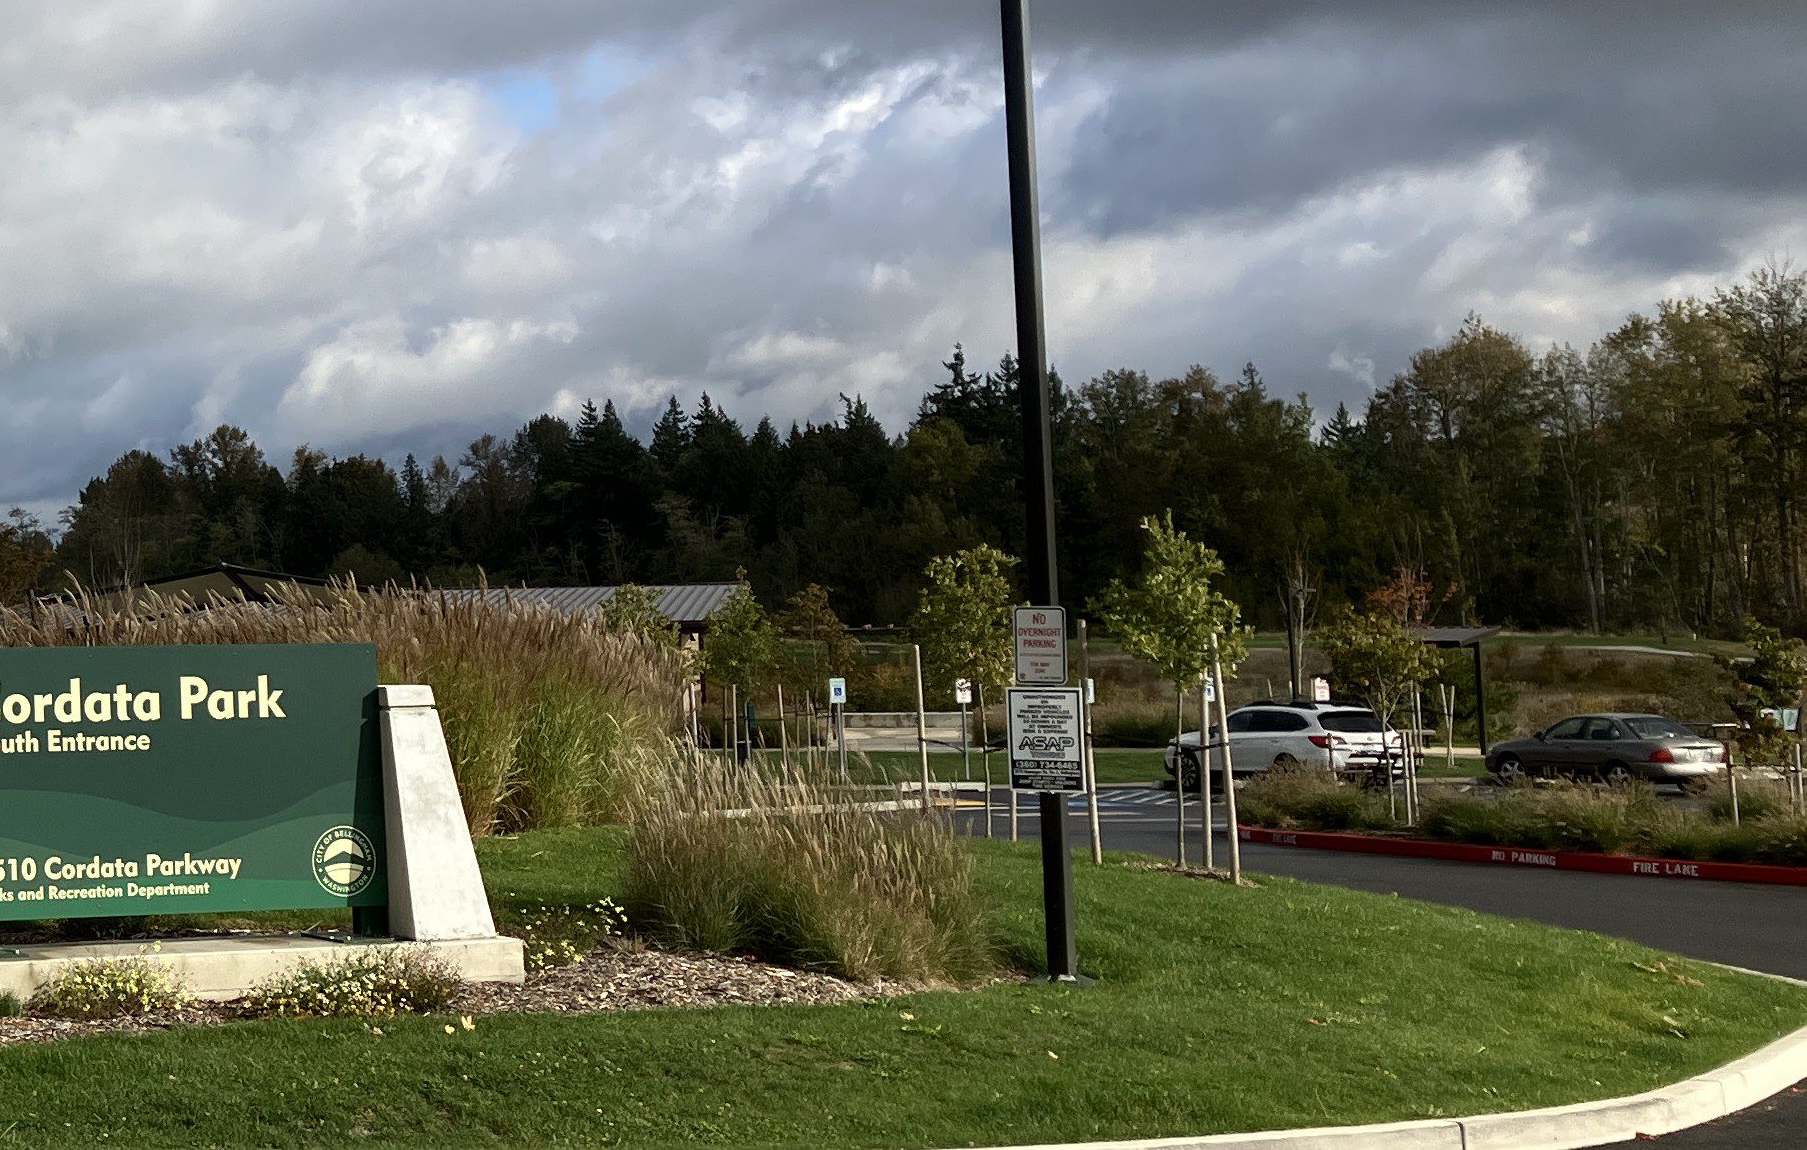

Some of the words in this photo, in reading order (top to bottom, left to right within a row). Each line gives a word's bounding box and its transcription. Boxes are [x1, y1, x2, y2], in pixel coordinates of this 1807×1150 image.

[1032, 614, 1046, 624] NO
[1018, 628, 1061, 636] OVERNIGHT
[1023, 639, 1057, 648] PARKING
[180, 675, 286, 719] Park
[48, 729, 150, 752] Entrance
[1019, 736, 1075, 751] ASAP
[316, 844, 325, 864] CITY
[323, 834, 333, 845] OF
[334, 830, 372, 862] BELLINGHAM
[1492, 850, 1506, 862] NO
[1511, 852, 1557, 866] PARKING
[44, 856, 138, 881] Cordata
[147, 853, 242, 881] Parkway
[1633, 861, 1660, 874] FIRE
[1666, 863, 1699, 877] LANE
[18, 886, 44, 901] and
[48, 884, 124, 900] Recreation
[128, 881, 211, 900] Department
[322, 874, 369, 893] WASHINGTON
